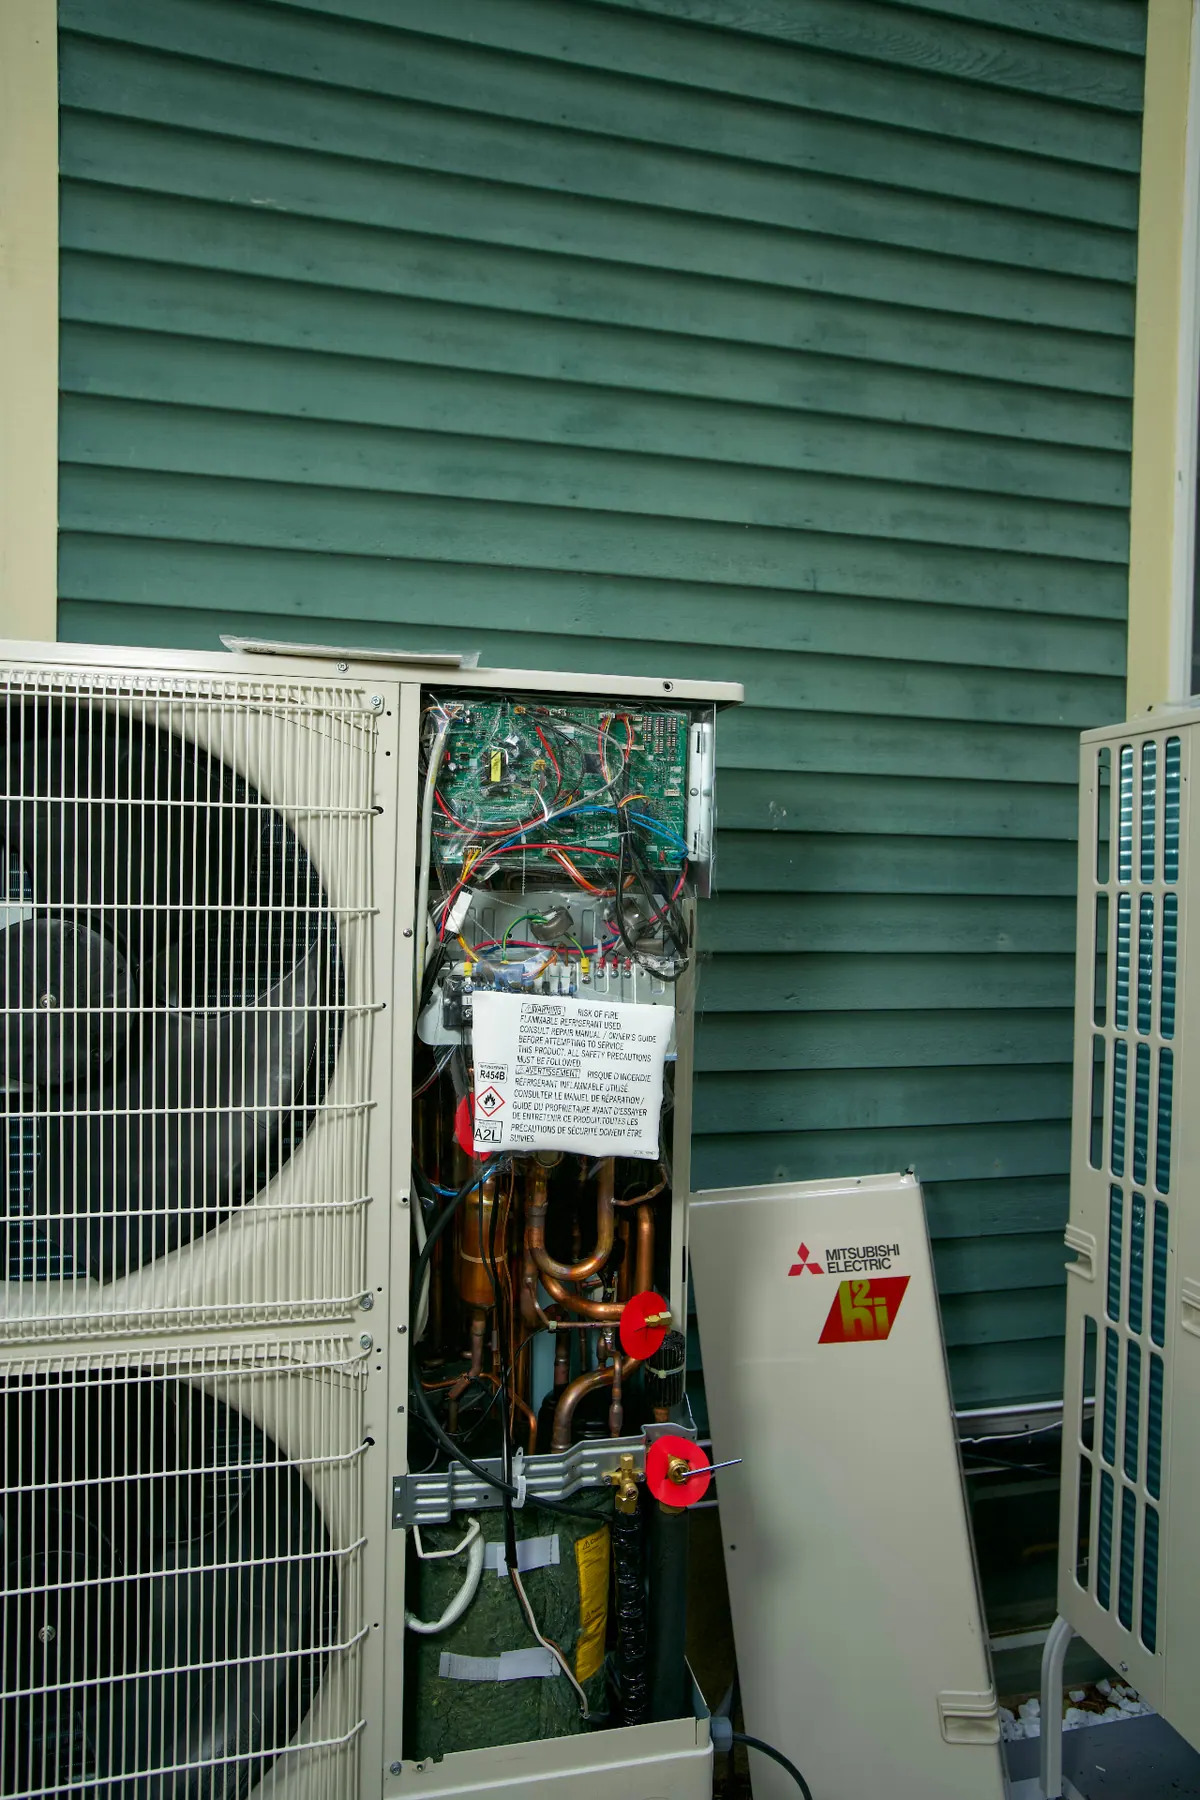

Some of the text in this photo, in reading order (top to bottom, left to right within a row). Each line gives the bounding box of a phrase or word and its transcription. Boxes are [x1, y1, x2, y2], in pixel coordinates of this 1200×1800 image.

[578, 1009, 592, 1017] RISK
[594, 1010, 602, 1018] OF
[604, 1011, 619, 1019] FIRE
[520, 1015, 558, 1025] FLAMMABLE
[560, 1018, 602, 1028] REFRIGERANT
[520, 1025, 550, 1034] CONSULT
[552, 1028, 574, 1036] REPAIR
[576, 1030, 600, 1038] MANUAL
[608, 1032, 636, 1042] OWNER'S
[638, 1034, 656, 1043] GUIDE
[518, 1035, 544, 1044] BEFORE
[545, 1037, 586, 1048] ATTEMPTING
[598, 1041, 624, 1050] SERVICE
[517, 1056, 534, 1064] MUST
[518, 1045, 532, 1053] THIS
[568, 1049, 579, 1057] ALL
[582, 1050, 606, 1058] SAFETY
[607, 1052, 652, 1062] PRECAUTIONS
[480, 1070, 505, 1080] R454B
[588, 1070, 612, 1080] RISQUE
[560, 1080, 604, 1091] INFLAMMABLE
[514, 1089, 552, 1099] CONSULTER
[555, 1092, 562, 1100] LE
[564, 1092, 588, 1102] MANUEL
[591, 1094, 600, 1102] DE
[602, 1094, 640, 1104] RÉPARATION
[512, 1101, 532, 1110] GUIDE
[534, 1102, 543, 1111] DU
[592, 1106, 613, 1114] AVANT
[512, 1112, 520, 1120] DE
[522, 1112, 561, 1122] ENTRETENIR
[474, 1128, 500, 1142] A2L
[511, 1122, 556, 1134] PRÉCAUTIONS
[568, 1125, 598, 1136] SÉCURITÉ
[599, 1128, 625, 1136] DOIVENT
[627, 1128, 642, 1137] ÊTRE
[826, 1244, 900, 1261] MITSUBISHI
[827, 1258, 892, 1274] ELECTRIC
